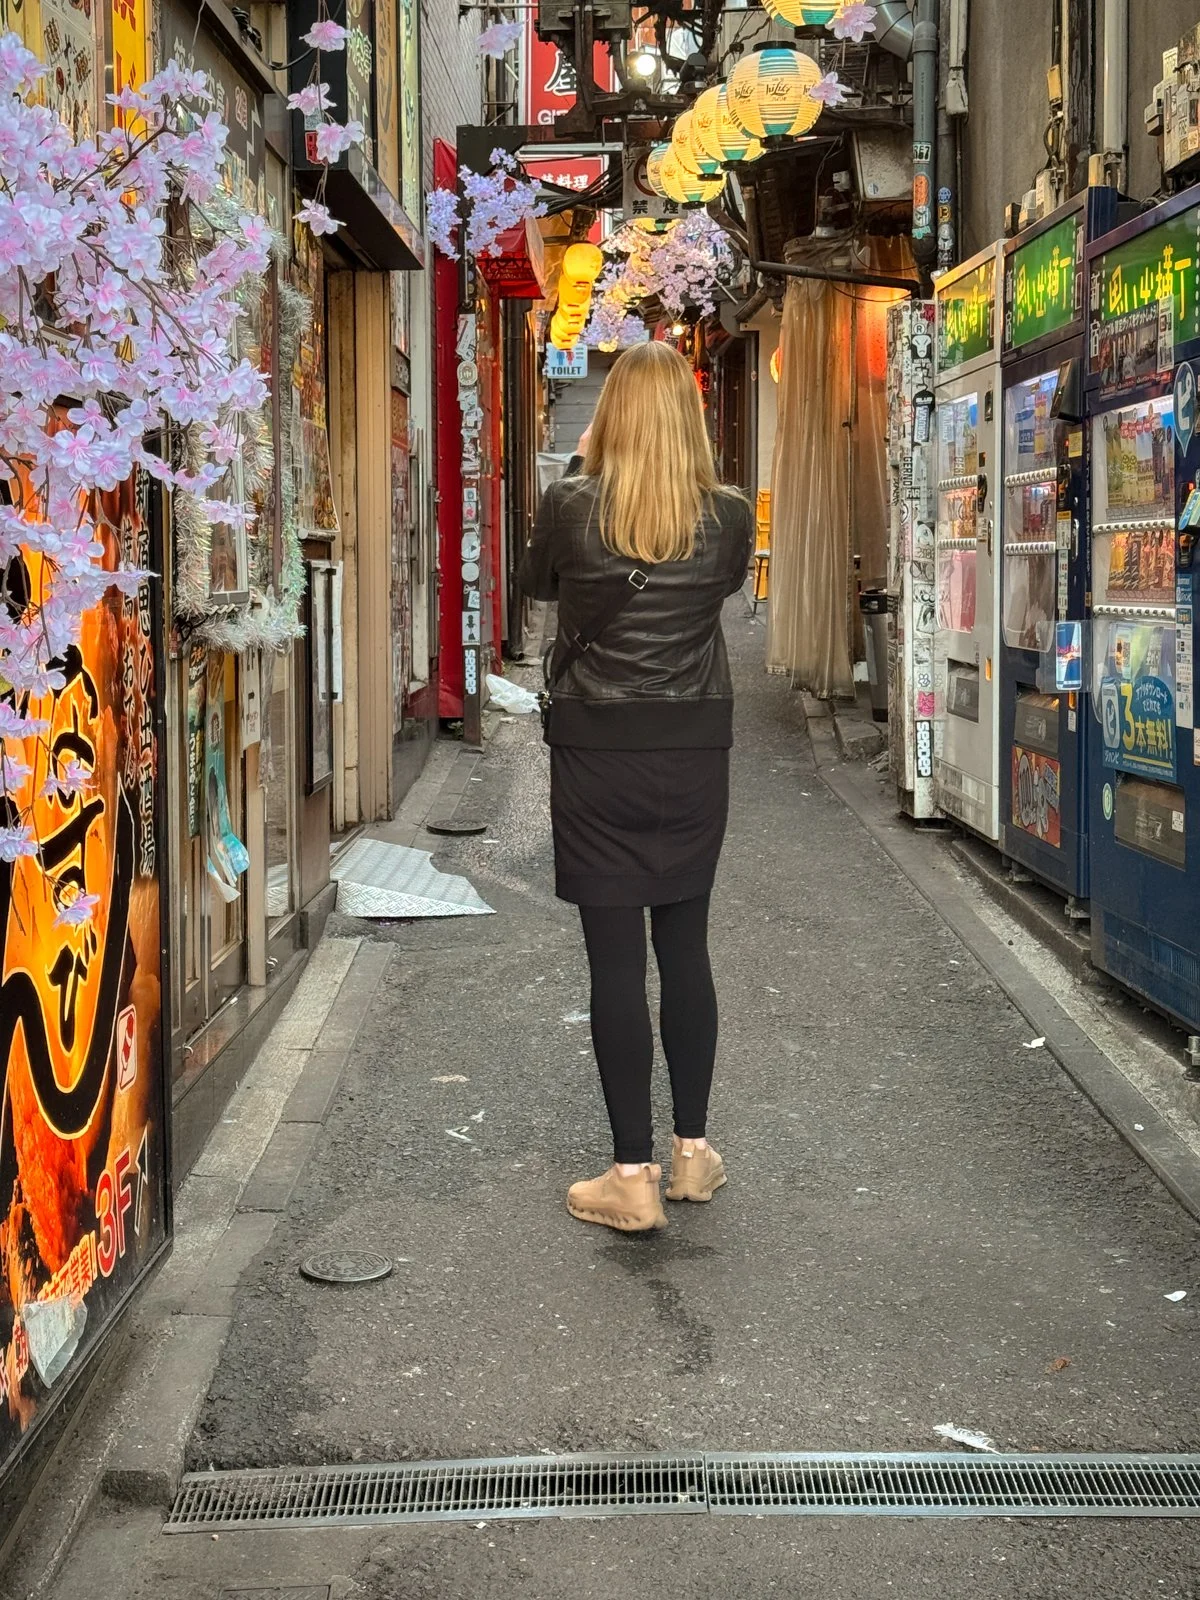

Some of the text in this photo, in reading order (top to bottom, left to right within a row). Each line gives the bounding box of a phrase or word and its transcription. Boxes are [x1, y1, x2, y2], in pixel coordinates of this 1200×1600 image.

[632, 199, 679, 215] 禁煙
[1090, 271, 1100, 359] 新宿
[551, 366, 582, 376] TOILET
[95, 1144, 132, 1278] 3F
